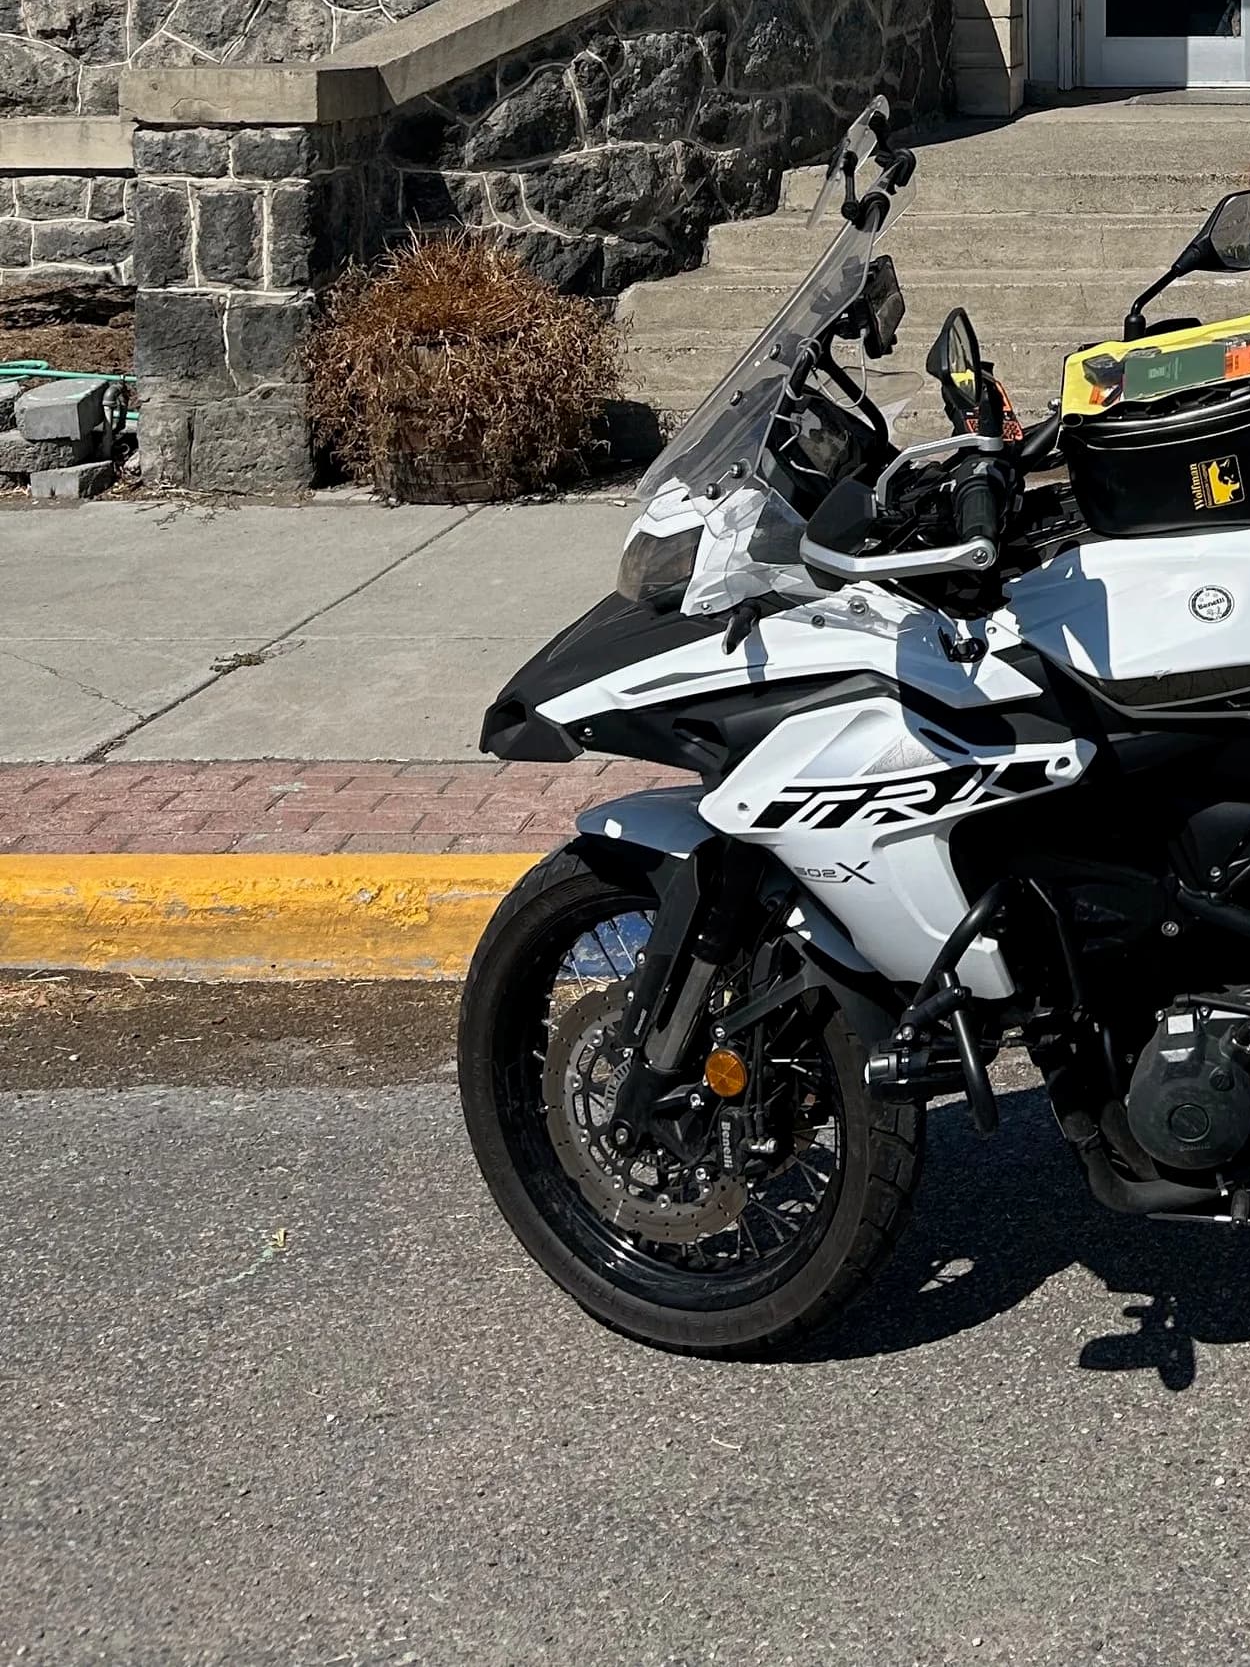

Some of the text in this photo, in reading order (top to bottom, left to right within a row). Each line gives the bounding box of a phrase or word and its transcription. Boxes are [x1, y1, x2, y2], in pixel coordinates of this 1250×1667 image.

[1188, 462, 1205, 511] Wolfman
[765, 762, 1022, 830] TRK
[720, 1120, 734, 1170] Benelli
